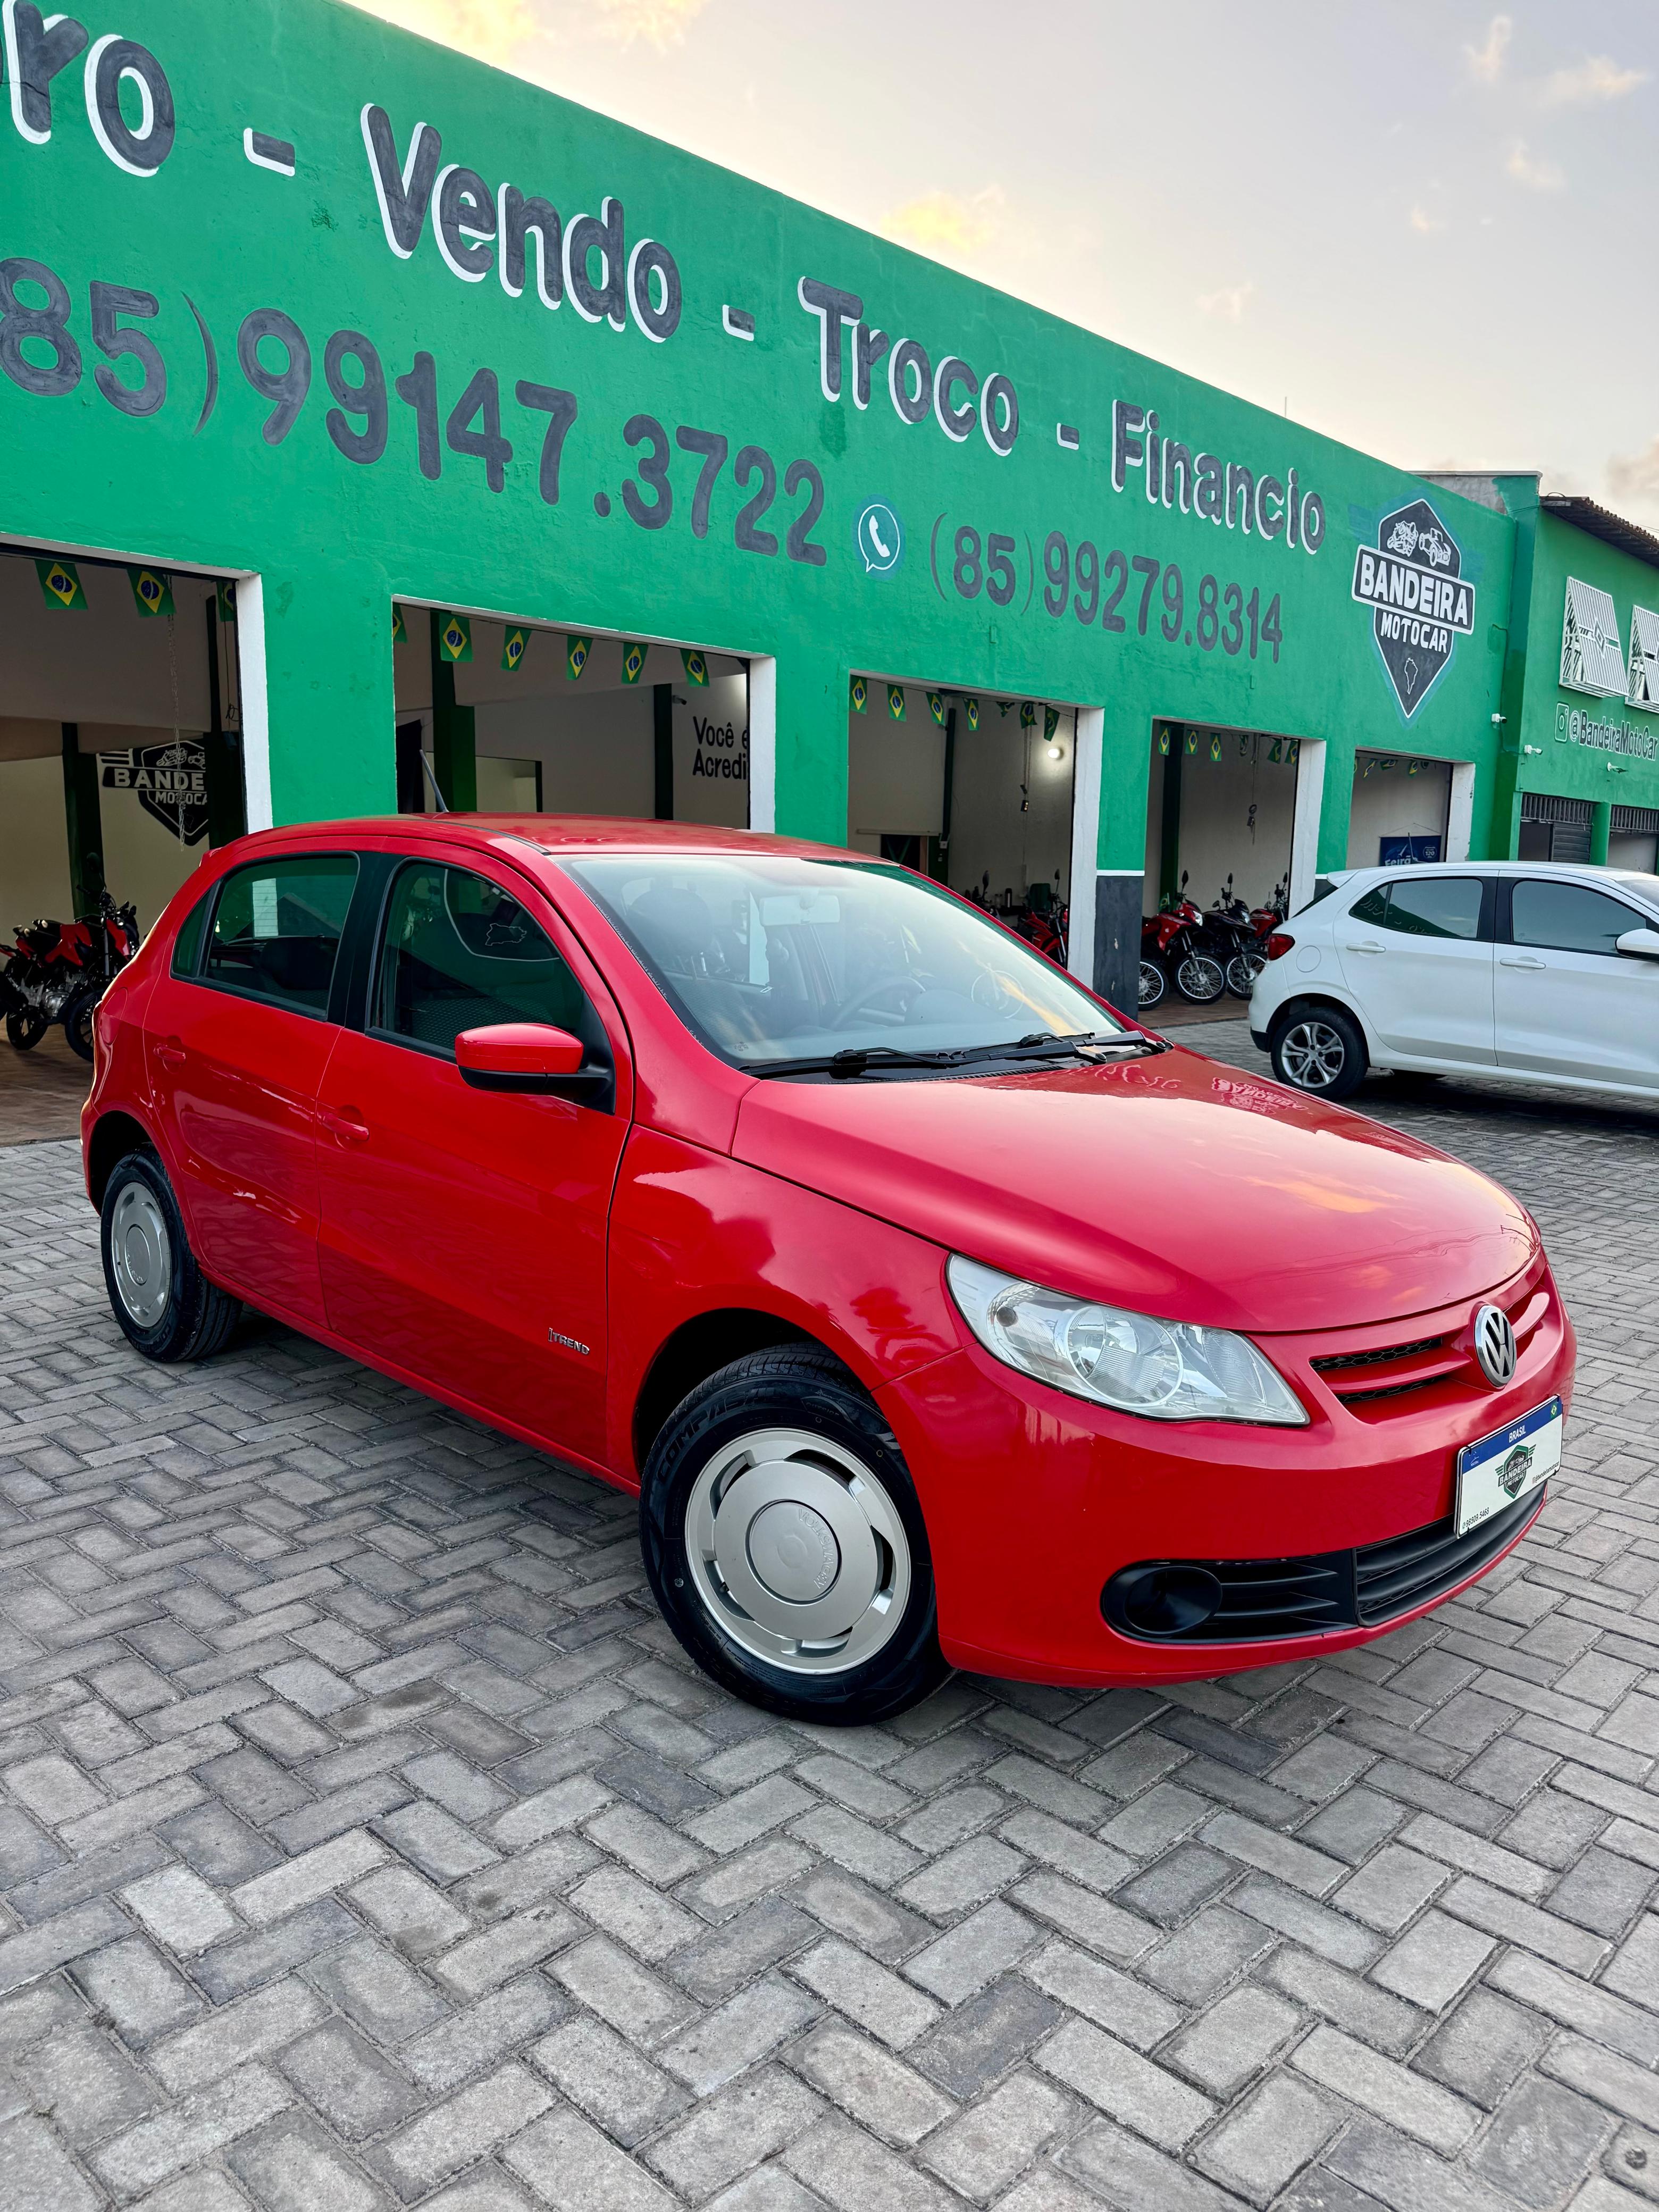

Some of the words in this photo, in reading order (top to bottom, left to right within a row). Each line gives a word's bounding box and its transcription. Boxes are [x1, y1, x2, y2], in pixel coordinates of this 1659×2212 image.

[0, 0, 175, 177] ro
[244, 128, 296, 176] -
[361, 103, 682, 343] Vendo
[722, 304, 755, 341] -
[798, 276, 1019, 456] Troco
[1057, 422, 1079, 450] -
[1112, 399, 1326, 555] Financio
[1360, 554, 1468, 625] BANDEIRA
[1380, 612, 1447, 653] MOTOCAR
[693, 716, 734, 748] Você
[1570, 709, 1658, 761] @BandeiraMotoCar
[114, 768, 205, 791] BANDE
[693, 749, 746, 780] Acredi
[1509, 1425, 1526, 1443] BRASIL
[1499, 1459, 1531, 1485] BANDEIRA
[799, 1509, 834, 1589] VOLKSWAGEN
